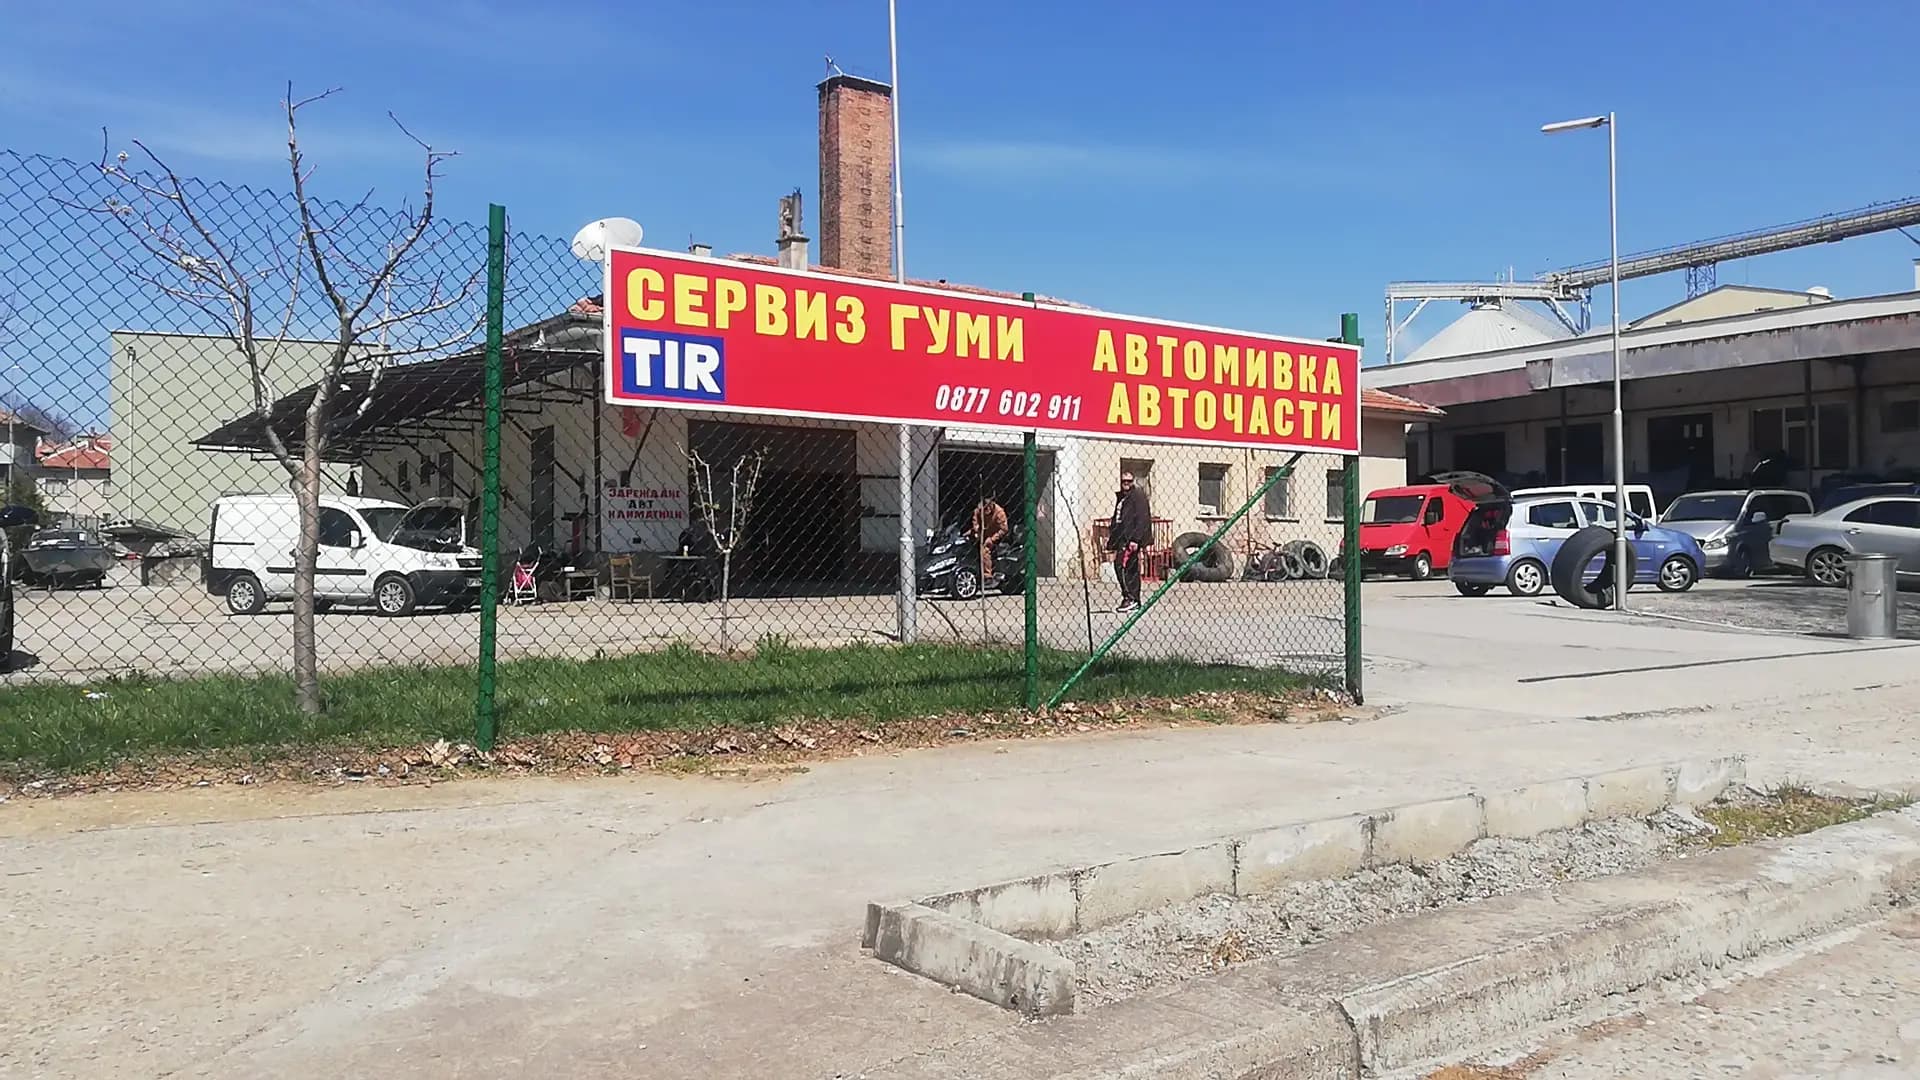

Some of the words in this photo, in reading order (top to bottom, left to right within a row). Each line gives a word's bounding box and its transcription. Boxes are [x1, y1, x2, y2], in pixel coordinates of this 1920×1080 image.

[626, 268, 866, 345] СЕРВИЗ
[890, 303, 1024, 362] ГУМИ
[623, 336, 722, 394] TIR
[1092, 329, 1343, 395] АВТОМИВКА
[935, 384, 990, 414] 0877
[998, 389, 1042, 418] 602
[1047, 394, 1082, 421] 911
[1106, 381, 1342, 441] АВТОЧАСТИ
